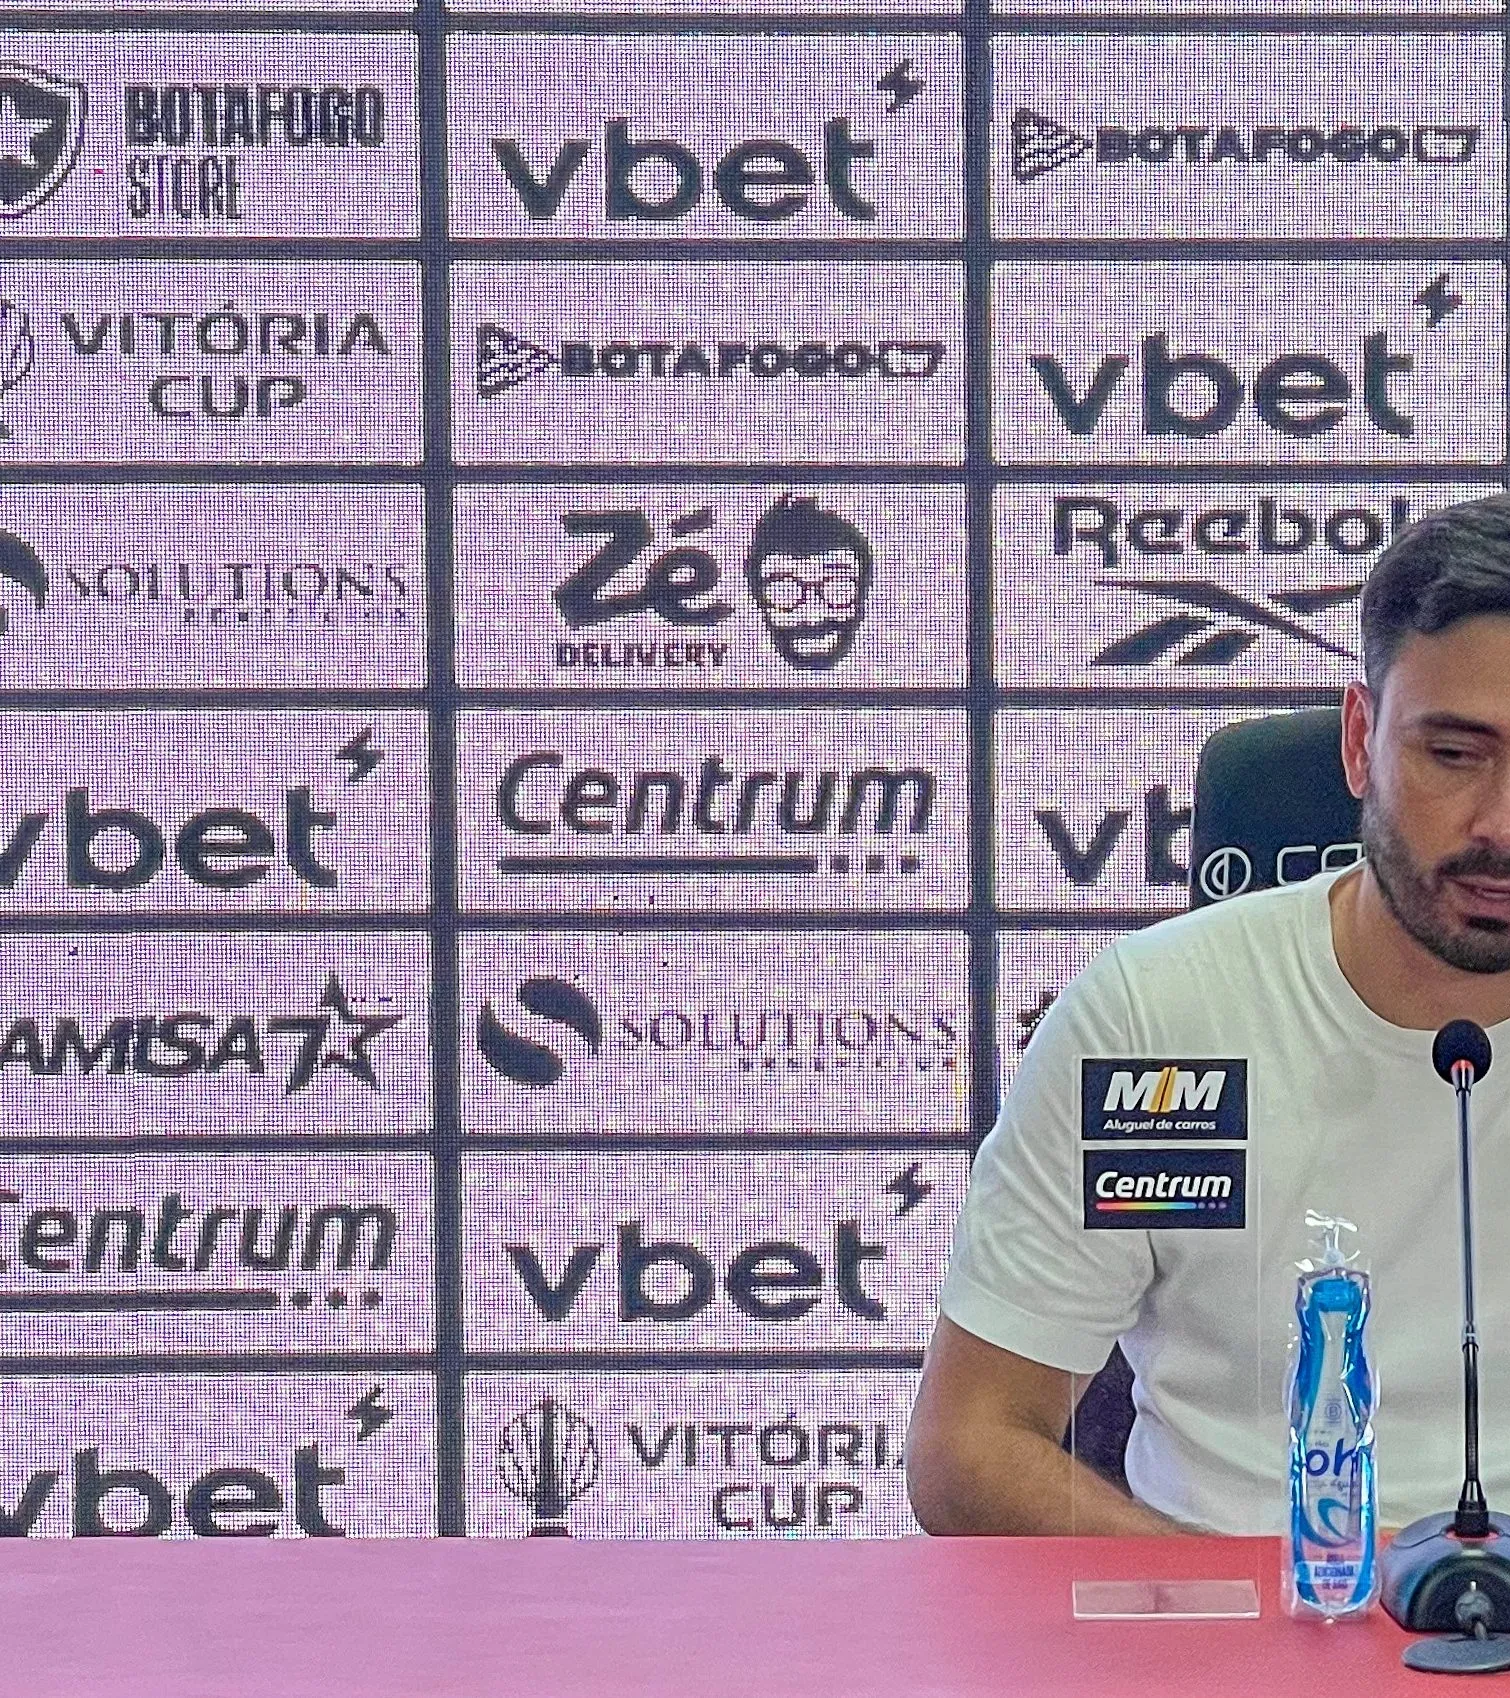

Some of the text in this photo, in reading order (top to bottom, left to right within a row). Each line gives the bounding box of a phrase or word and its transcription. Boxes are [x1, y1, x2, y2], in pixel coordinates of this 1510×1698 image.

[125, 84, 385, 147] BOTAFOGO
[492, 117, 877, 219] vbet
[1097, 126, 1408, 162] BOTAFOGO
[62, 300, 390, 355] VITÓRIA
[562, 341, 871, 377] BOTAFOGO
[1030, 331, 1412, 437] vbet
[150, 375, 304, 418] CUP
[68, 562, 406, 601] SOLUTIONS
[555, 505, 735, 630] Zé
[556, 642, 727, 667] DELIVERY
[498, 750, 936, 834] Centrum
[620, 1009, 957, 1051] SOLUTIONS
[1103, 1118, 1216, 1133] Aluguel de carros
[1096, 1171, 1232, 1198] Centrum
[0, 1190, 399, 1273] entrum
[506, 1220, 885, 1322] vbet
[628, 1413, 904, 1467] VITÓRI
[714, 1485, 862, 1531] CUP
